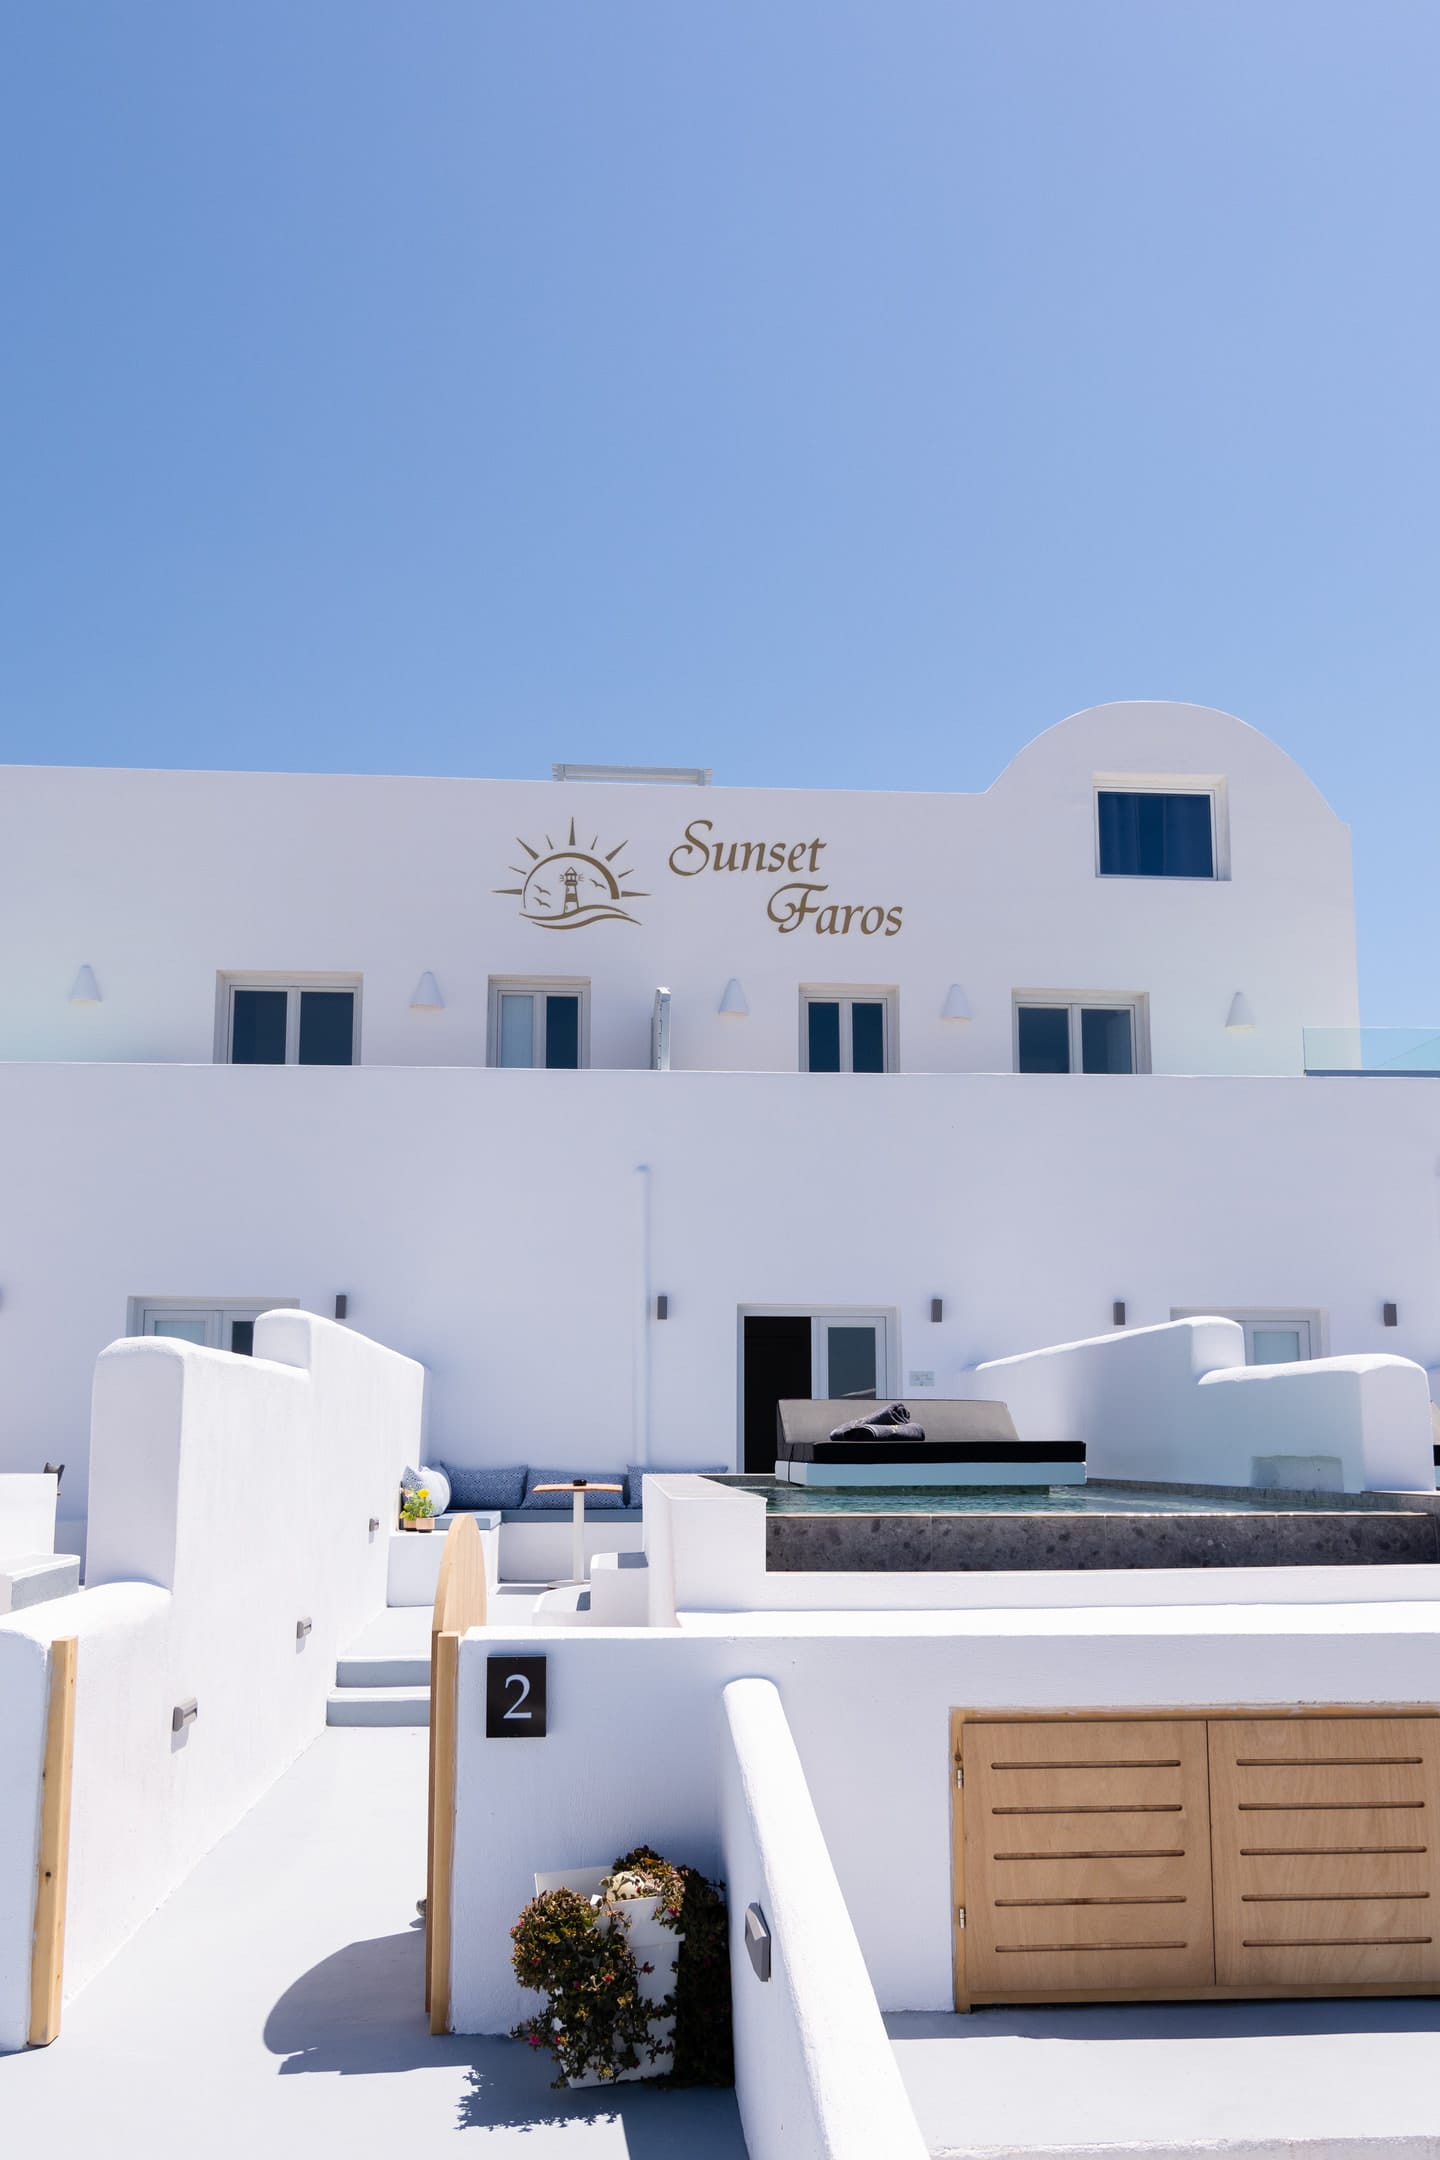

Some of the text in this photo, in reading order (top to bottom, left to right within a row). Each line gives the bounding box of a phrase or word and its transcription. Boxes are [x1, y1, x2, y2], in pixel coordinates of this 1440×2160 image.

[668, 819, 828, 877] Sunset
[766, 882, 904, 937] Faros
[503, 1673, 532, 1719] 2
